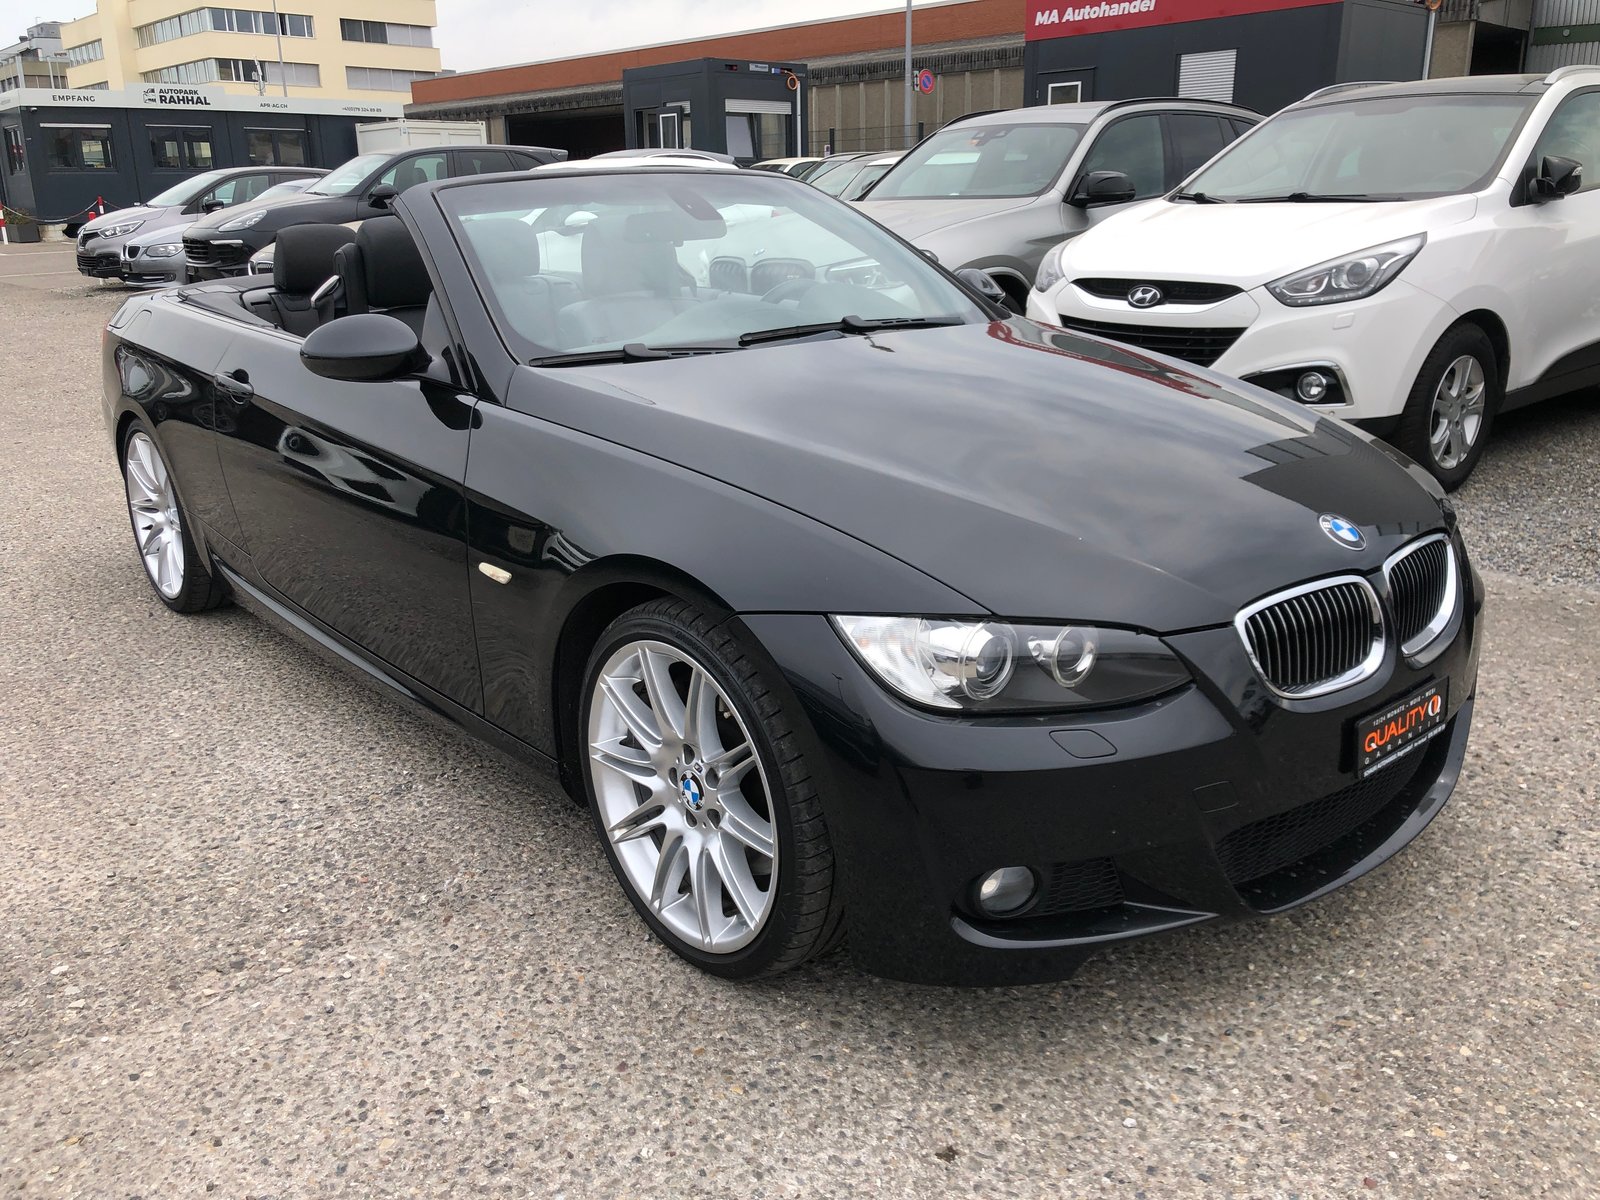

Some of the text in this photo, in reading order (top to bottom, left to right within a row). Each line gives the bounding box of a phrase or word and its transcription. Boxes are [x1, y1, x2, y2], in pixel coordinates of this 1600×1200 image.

[1035, 0, 1156, 25] MA Autohandel
[158, 88, 199, 96] AUTOPARK
[52, 94, 96, 102] EMPFANG
[159, 95, 211, 106] RAHHAL
[1365, 702, 1428, 752] QUALITY
